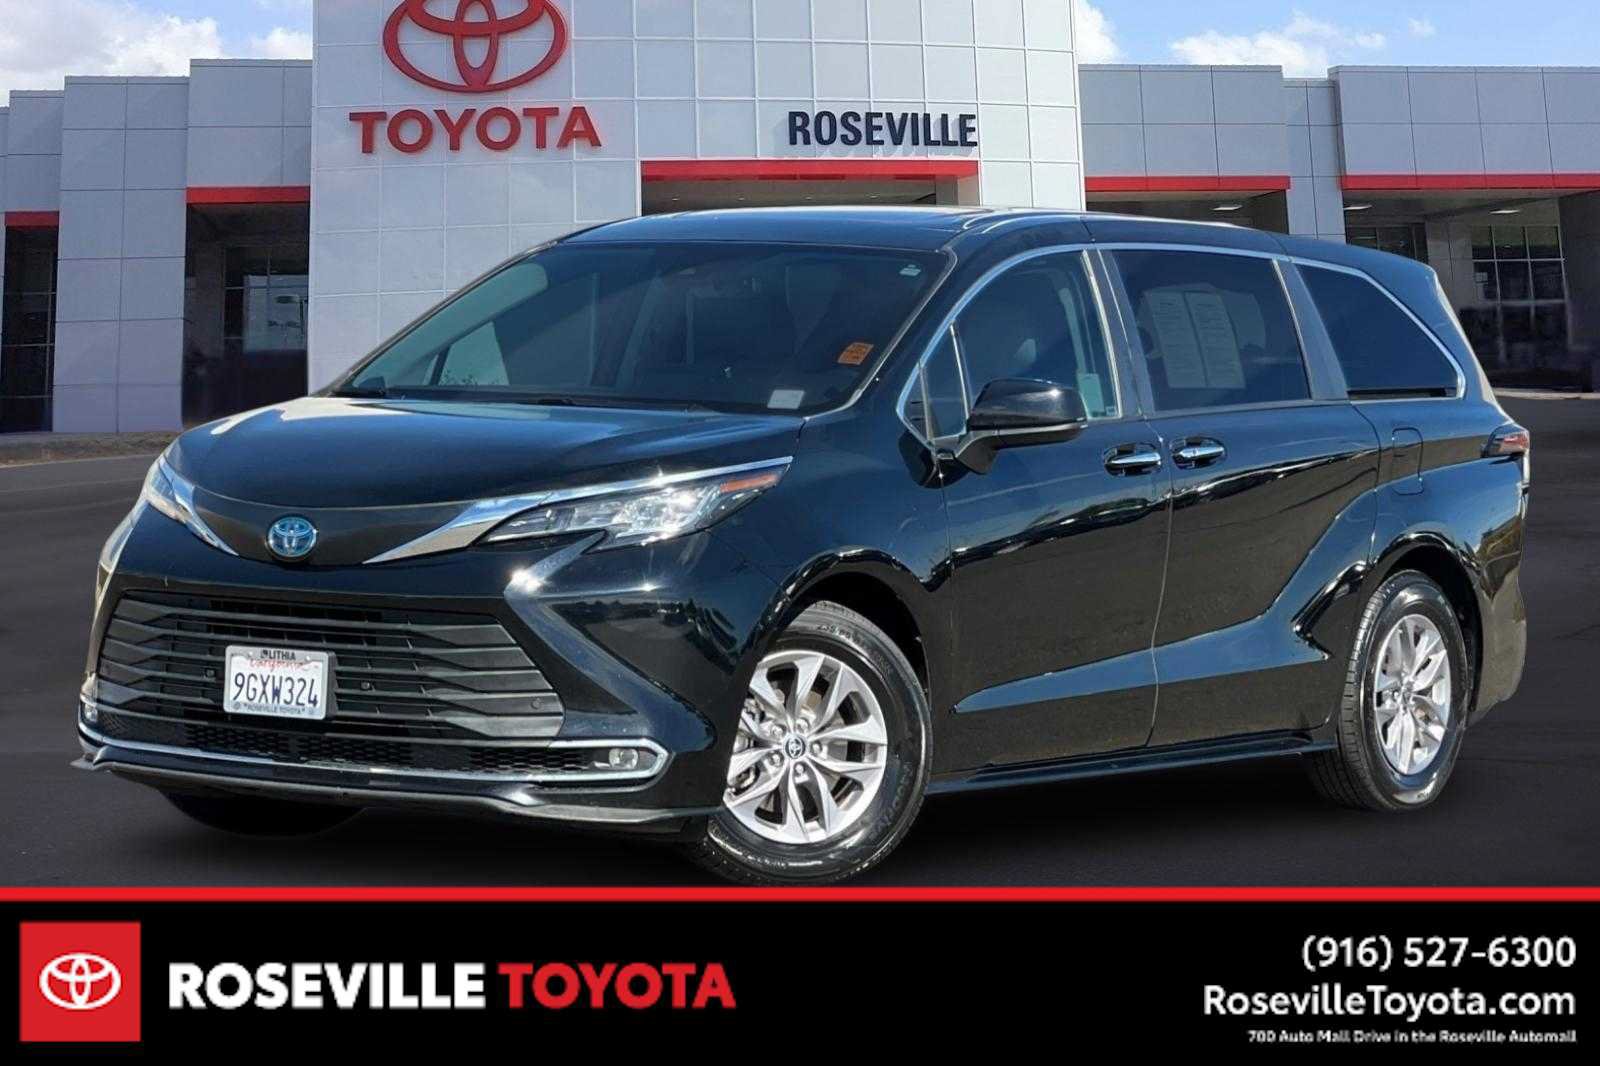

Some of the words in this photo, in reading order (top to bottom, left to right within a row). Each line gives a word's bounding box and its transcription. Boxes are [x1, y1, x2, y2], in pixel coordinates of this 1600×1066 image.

[349, 106, 602, 154] TOYOTA
[788, 111, 978, 147] ROSEVILLE
[268, 649, 296, 660] LITHIA
[233, 672, 318, 707] 9GXW324
